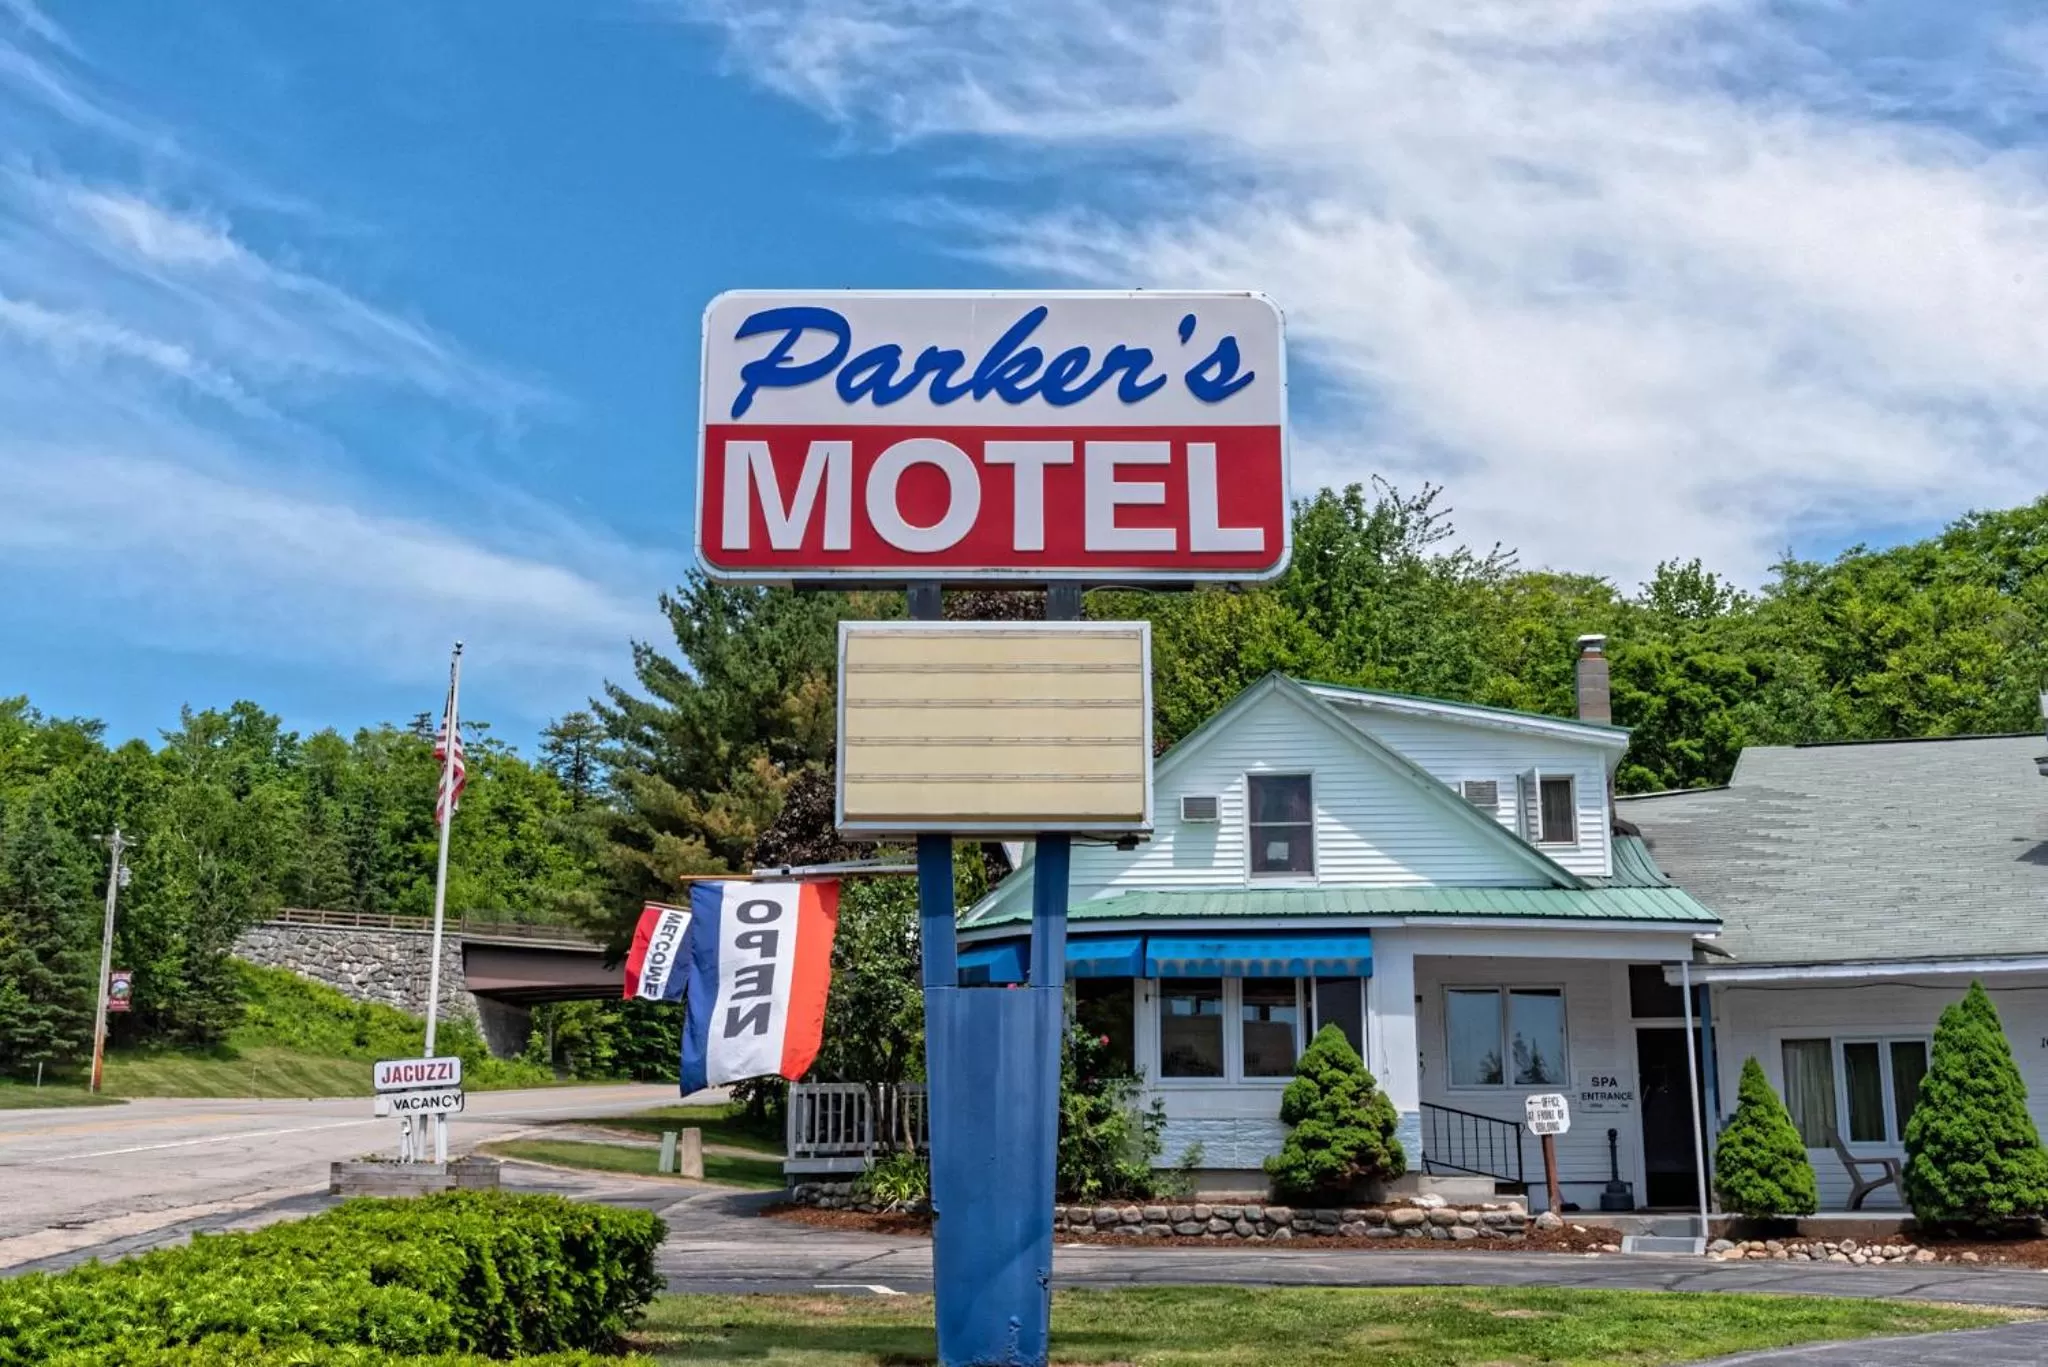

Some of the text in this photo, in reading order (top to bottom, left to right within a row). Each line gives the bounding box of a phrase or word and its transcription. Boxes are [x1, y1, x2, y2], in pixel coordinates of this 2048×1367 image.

[731, 305, 1255, 419] Parker's
[721, 438, 1265, 552] MOTEL
[381, 1062, 453, 1084] JACUZZI
[1591, 1076, 1618, 1087] SPA
[393, 1094, 461, 1110] VACANCY
[1581, 1091, 1633, 1101] ENTRANCE
